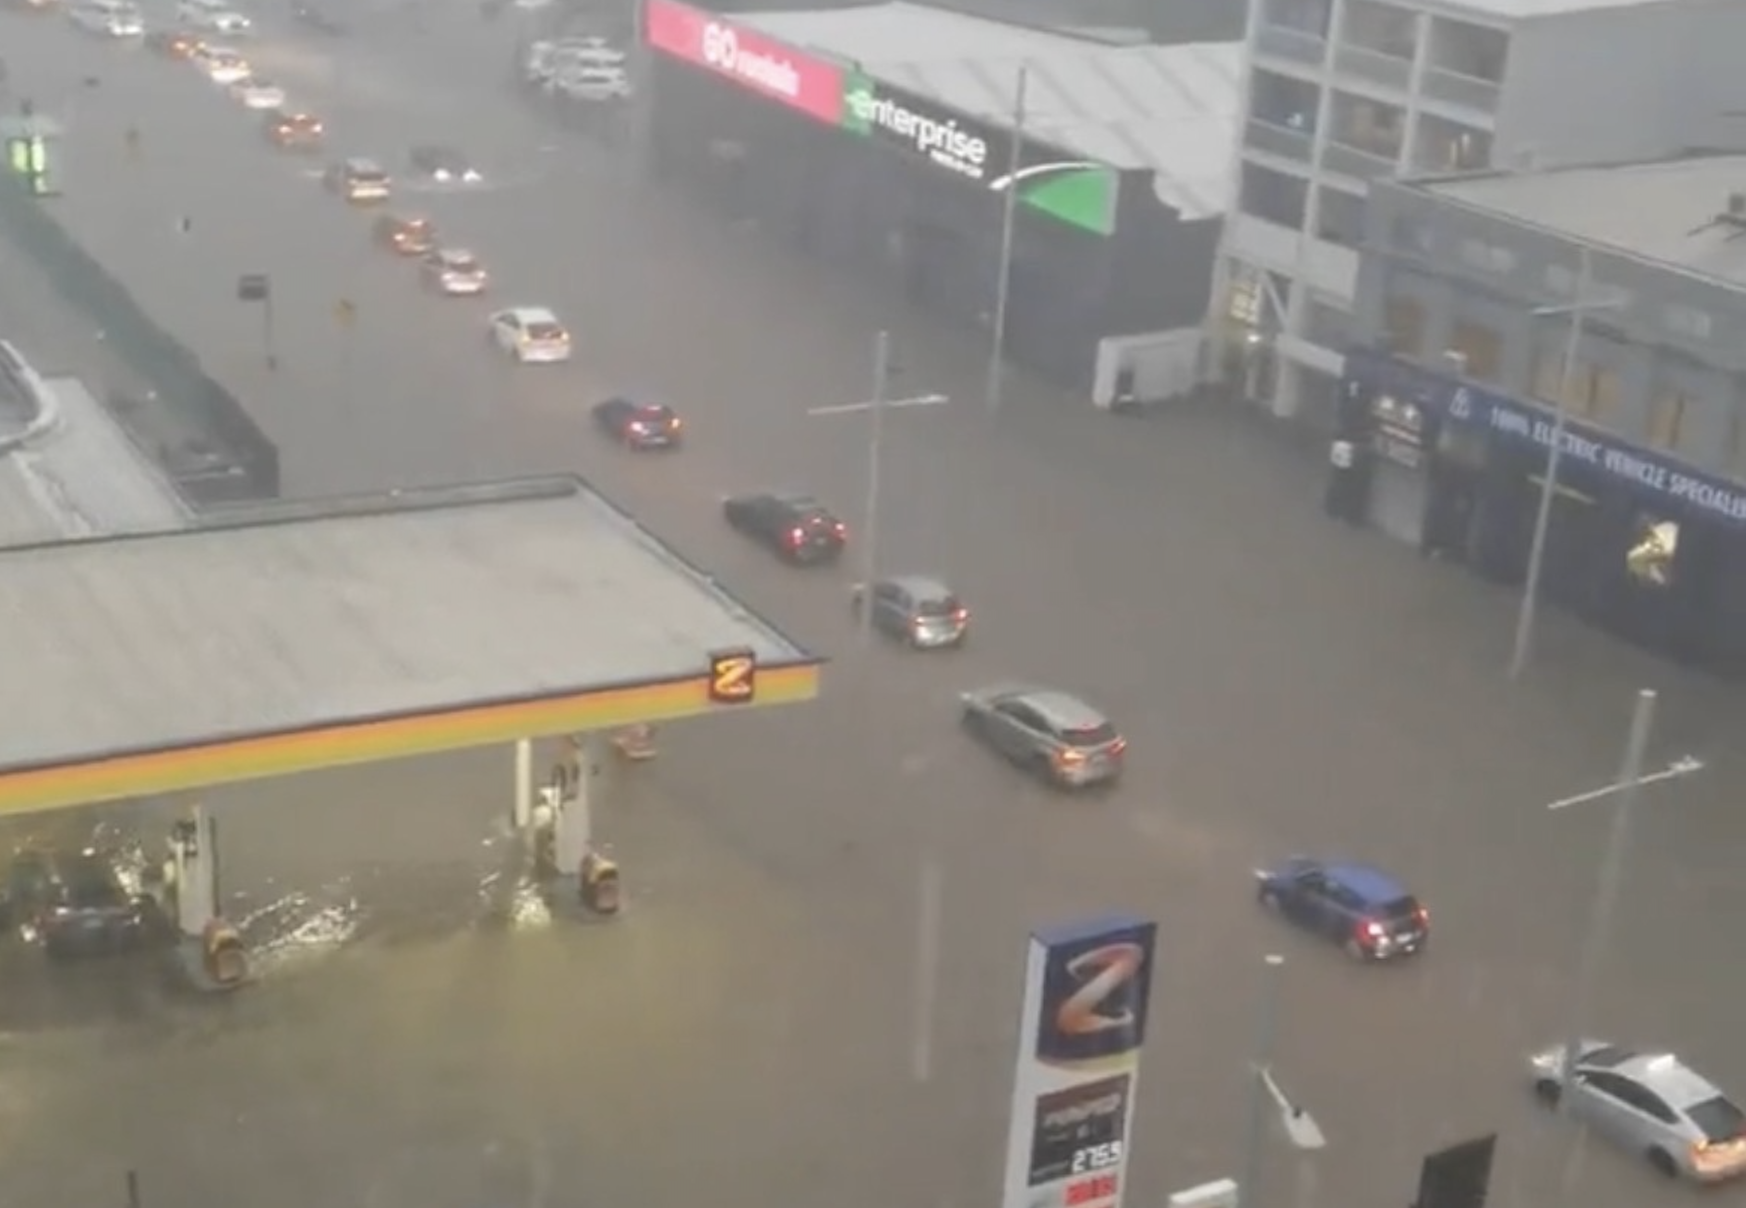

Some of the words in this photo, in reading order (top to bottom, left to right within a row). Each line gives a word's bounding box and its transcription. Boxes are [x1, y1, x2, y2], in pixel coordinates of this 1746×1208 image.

[703, 22, 737, 68] GO
[845, 90, 986, 164] enterprise
[1604, 449, 1667, 489] VEHICLE
[714, 657, 752, 695] Z
[1057, 942, 1144, 1036] Z
